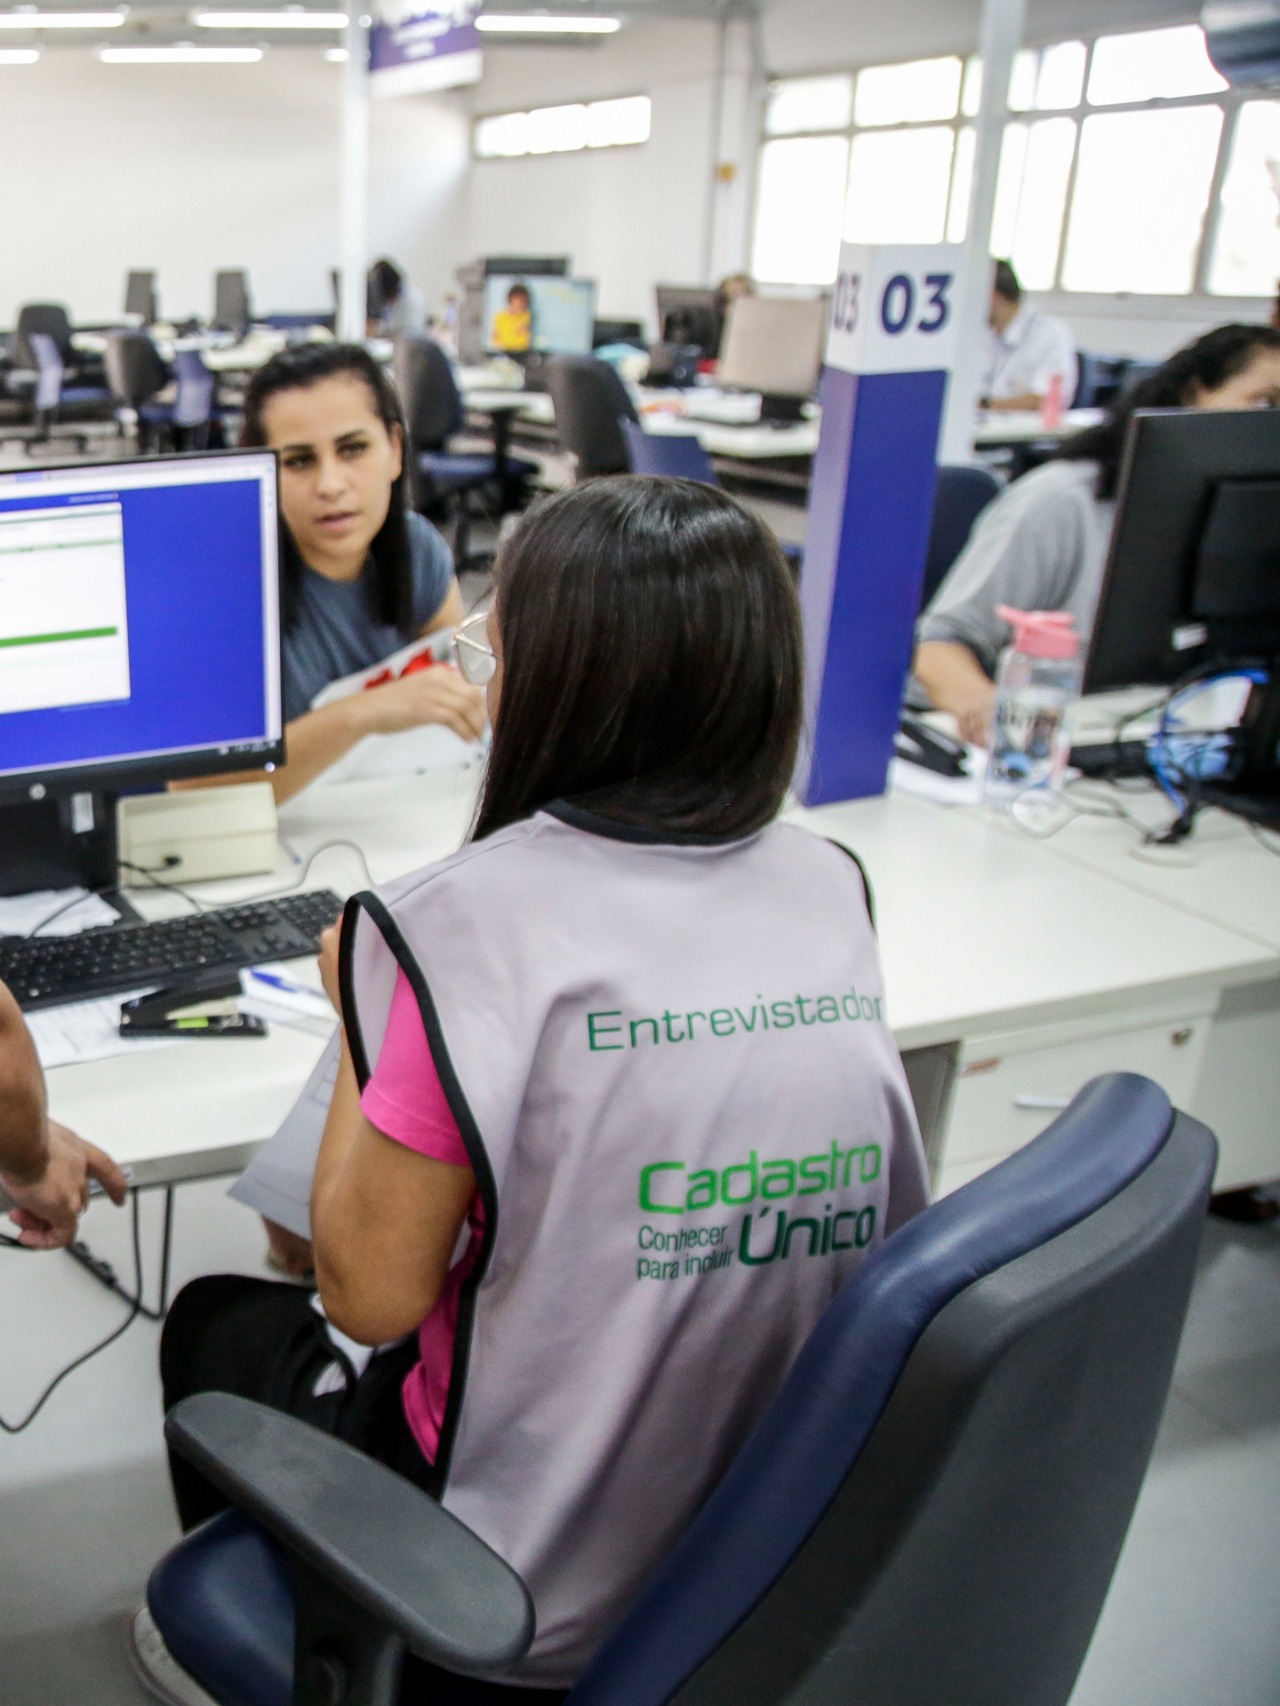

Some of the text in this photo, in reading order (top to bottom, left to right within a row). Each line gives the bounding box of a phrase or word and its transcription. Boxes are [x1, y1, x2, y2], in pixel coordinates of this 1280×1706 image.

[880, 272, 954, 334] 03
[587, 985, 882, 1052] Entrevistador
[638, 1137, 883, 1217] Cadastro
[637, 1247, 735, 1281] para incluir
[638, 1225, 728, 1252] Conhecer
[738, 1203, 877, 1267] Único
